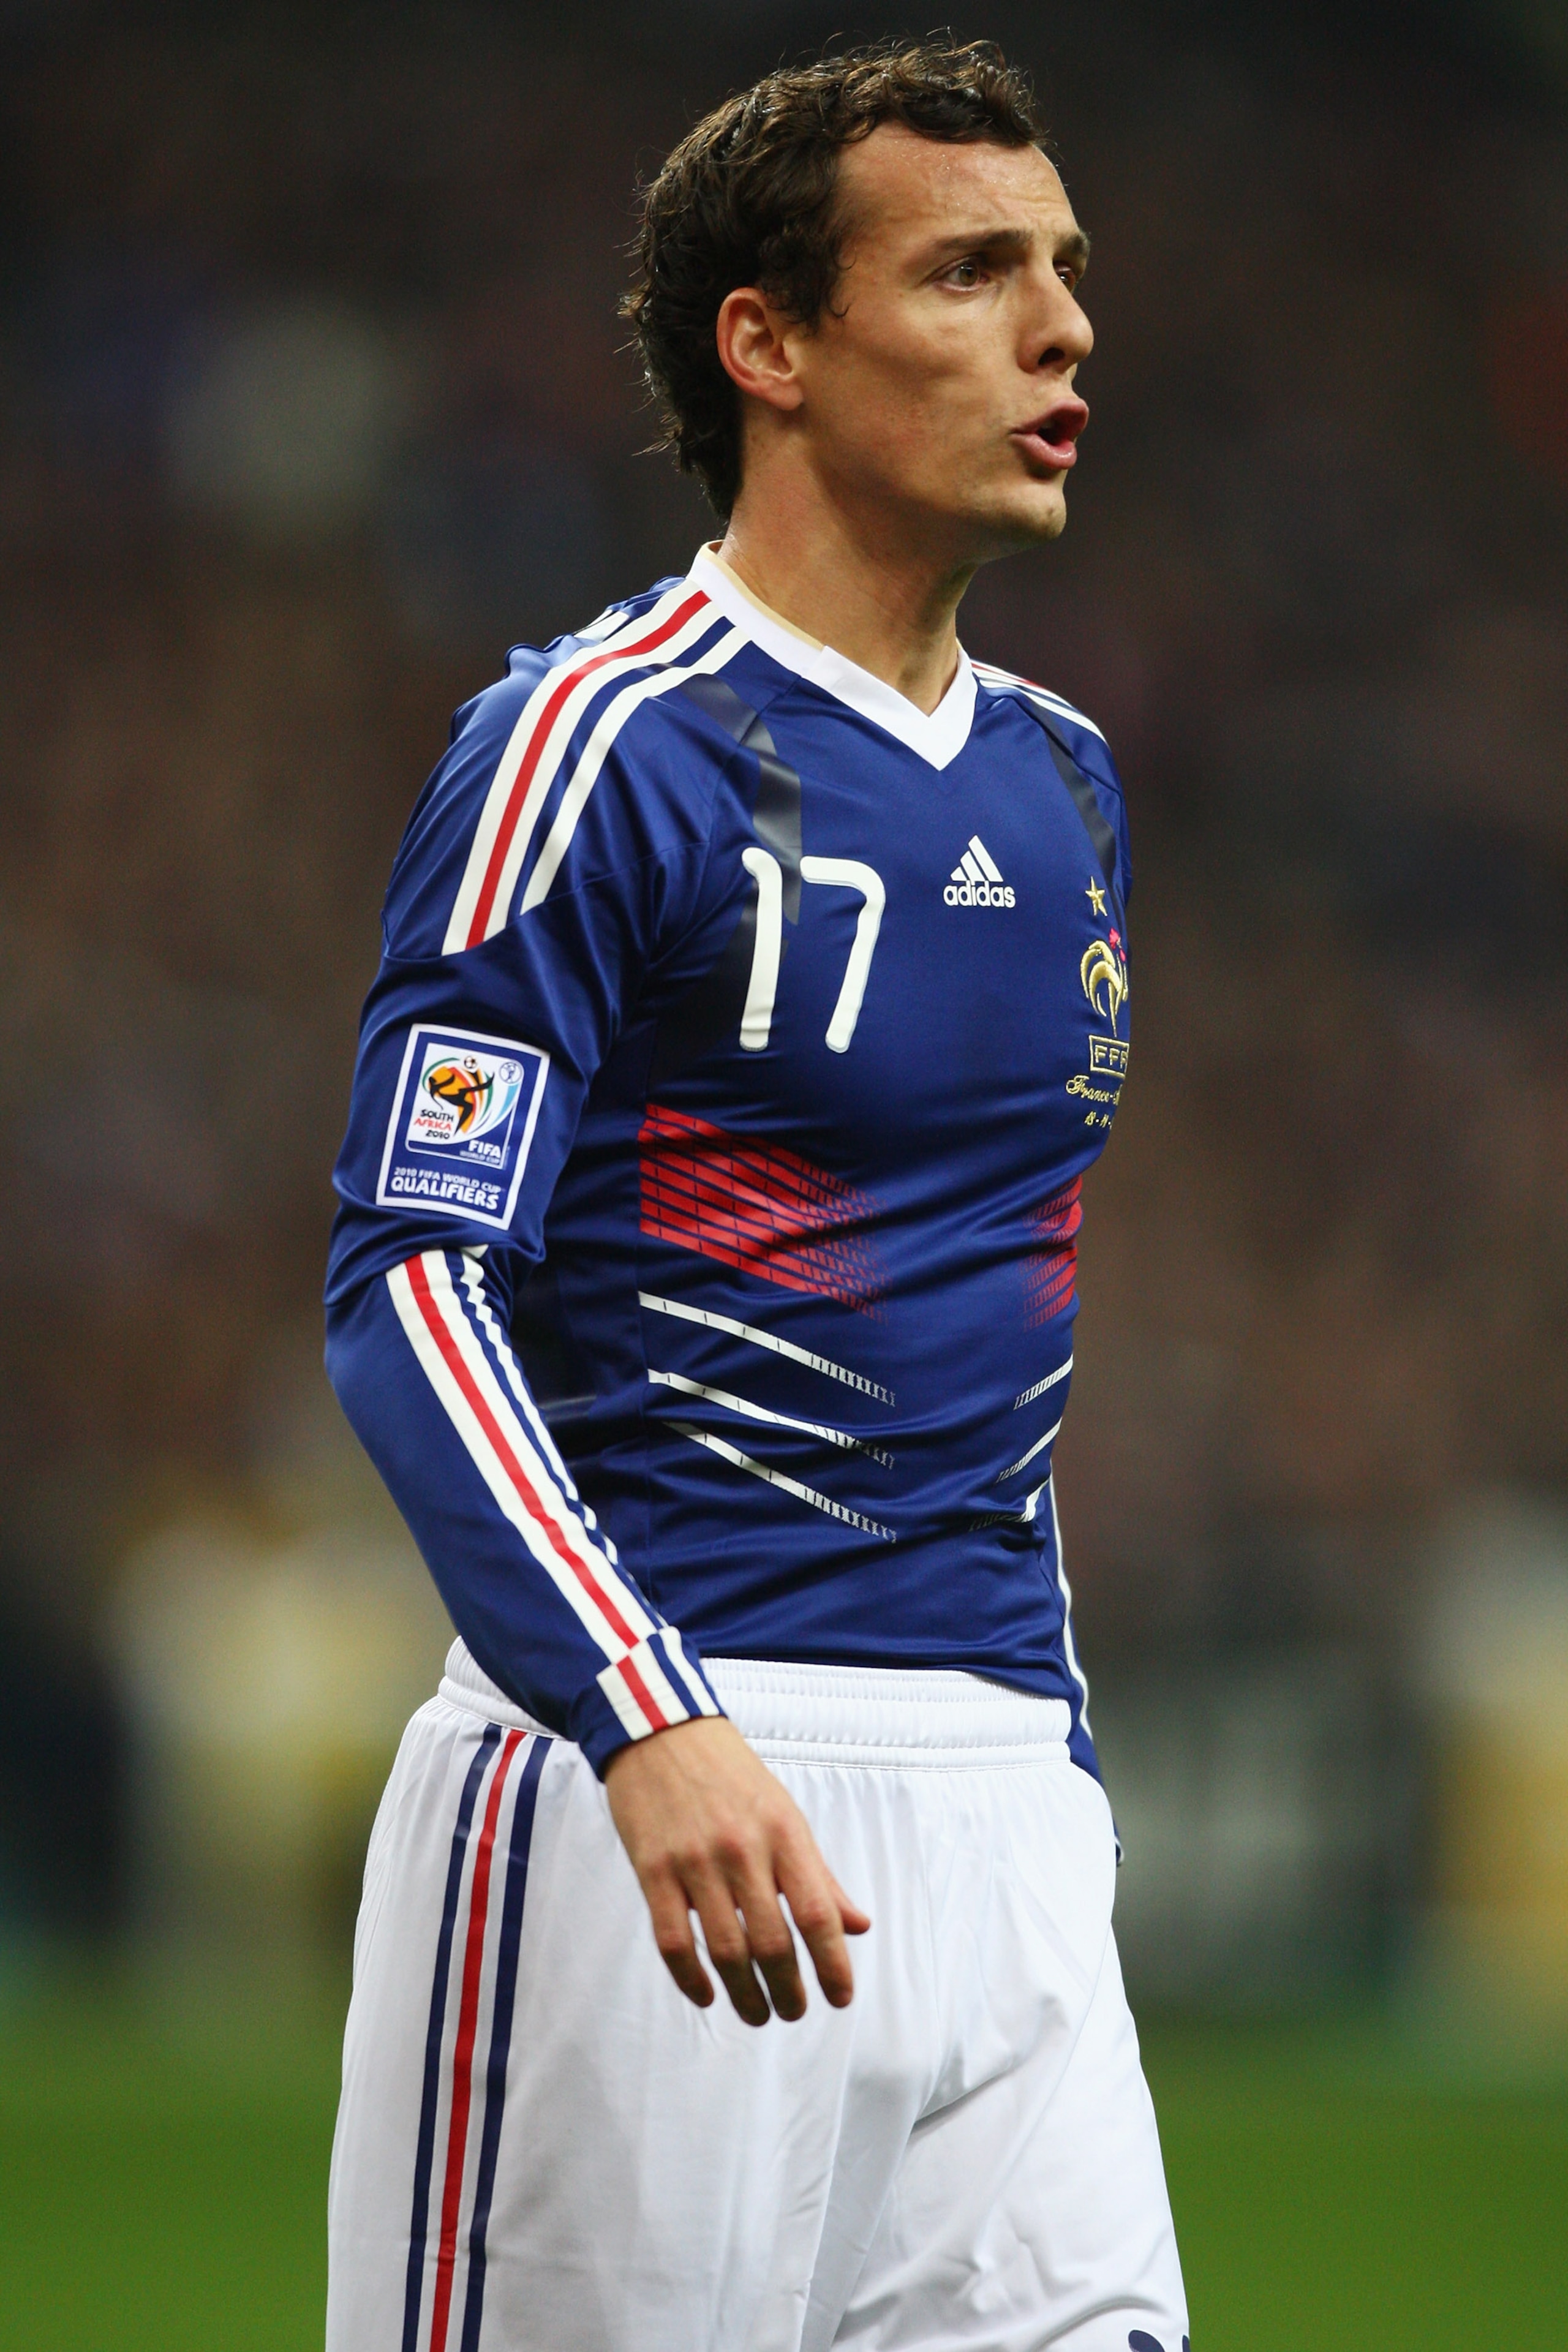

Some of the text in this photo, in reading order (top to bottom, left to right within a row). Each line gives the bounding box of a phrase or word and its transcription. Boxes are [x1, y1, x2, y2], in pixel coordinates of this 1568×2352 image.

[943, 881, 1016, 908] adidas
[739, 846, 886, 1054] 17
[414, 1118, 451, 1131] AFRICA
[420, 1109, 454, 1121] SOUTH
[426, 1130, 450, 1139] 2010
[469, 1139, 501, 1158] FIFA
[394, 1167, 501, 1194] 2010 FIFA WORLD CUP
[391, 1175, 499, 1210] QUALIFIERS
